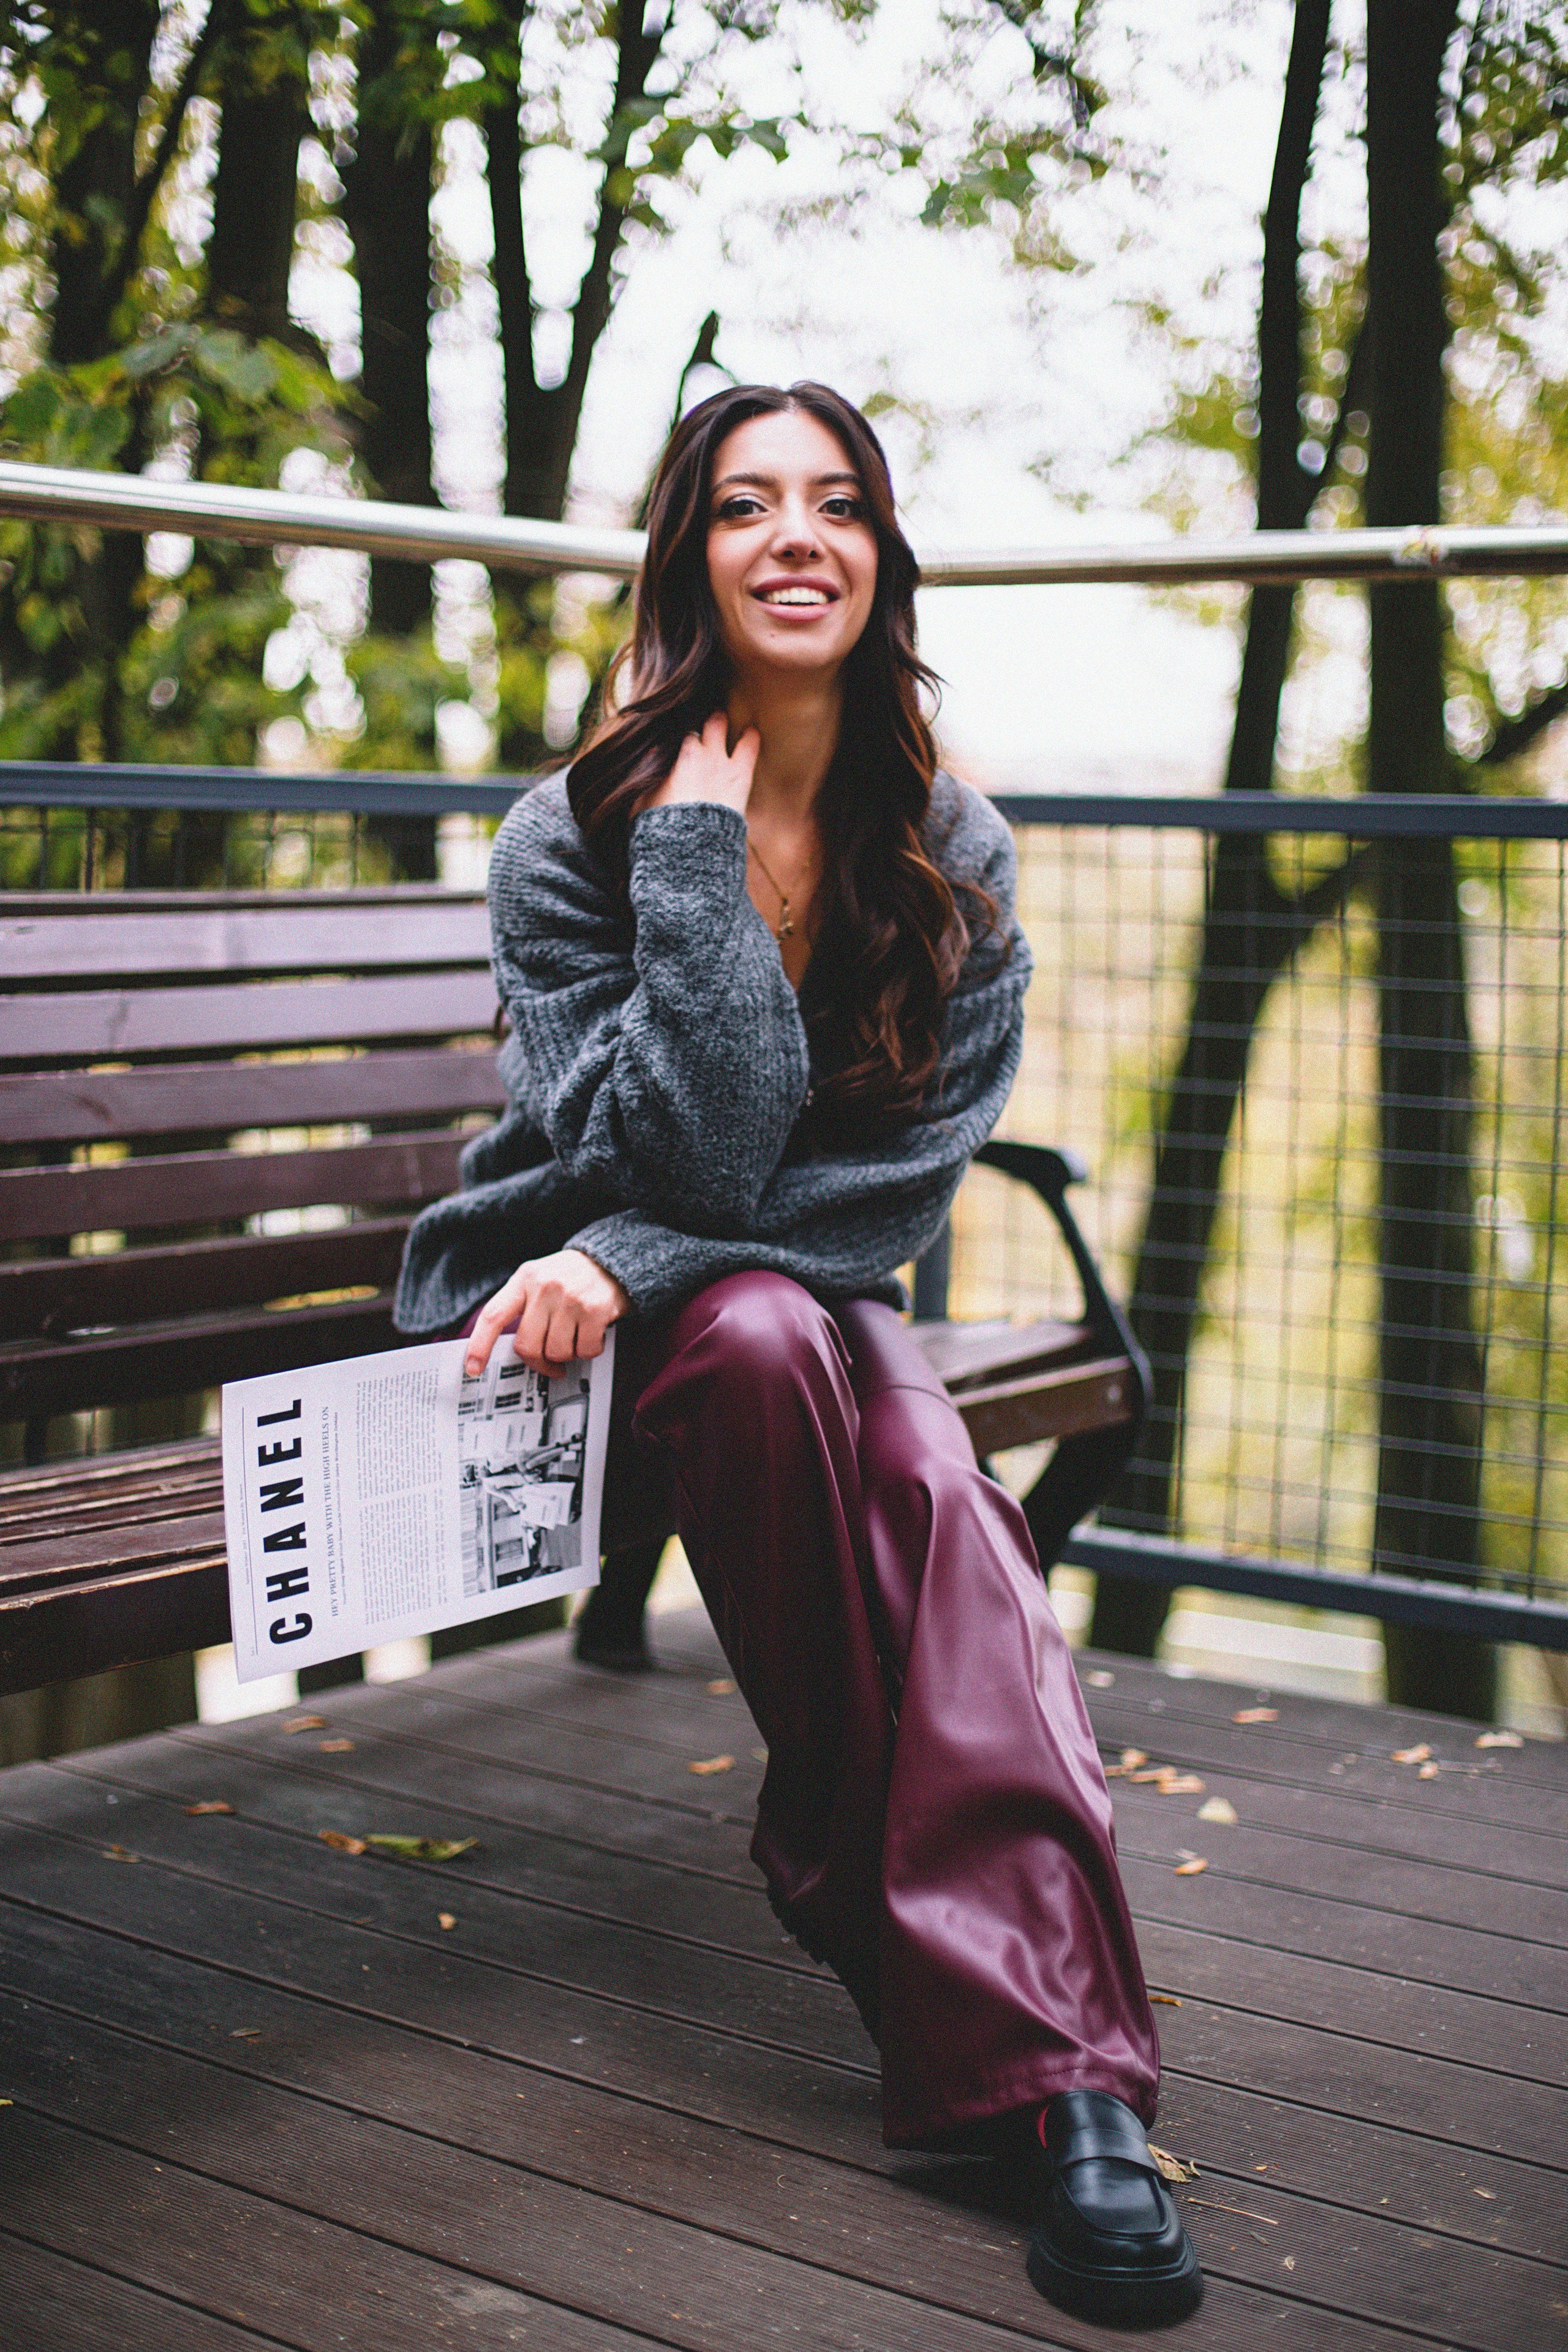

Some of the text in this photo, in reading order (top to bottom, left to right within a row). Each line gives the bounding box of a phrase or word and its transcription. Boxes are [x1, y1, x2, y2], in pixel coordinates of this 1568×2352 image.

[322, 1406, 329, 1421] ON
[322, 1455, 331, 1480] HIGH
[257, 1398, 313, 1645] CHANEL
[325, 1504, 333, 1531] WITH
[328, 1560, 337, 1596] PRETTY
[330, 1598, 339, 1617] HEY
